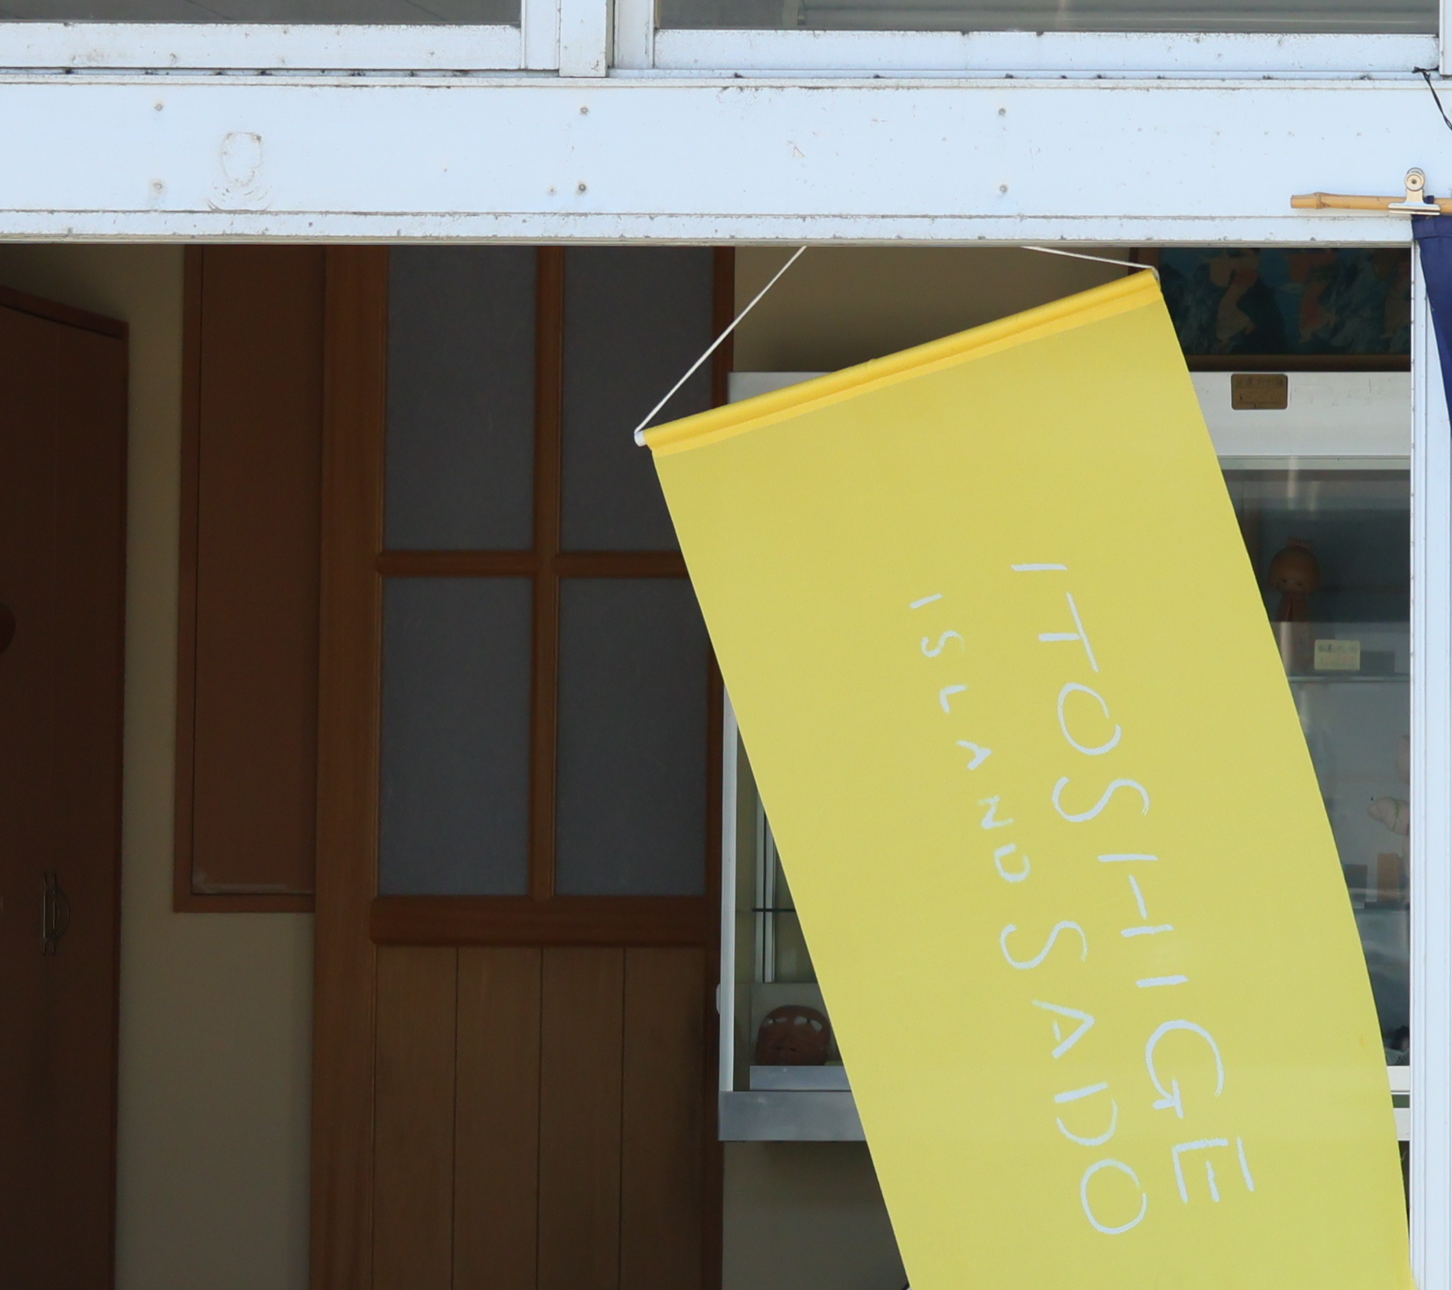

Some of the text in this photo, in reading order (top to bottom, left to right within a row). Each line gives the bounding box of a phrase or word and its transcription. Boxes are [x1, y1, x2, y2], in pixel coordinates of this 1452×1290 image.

[909, 593, 1148, 1237] ISLAND SADO
[1011, 561, 1254, 1203] ITOSHIGE
